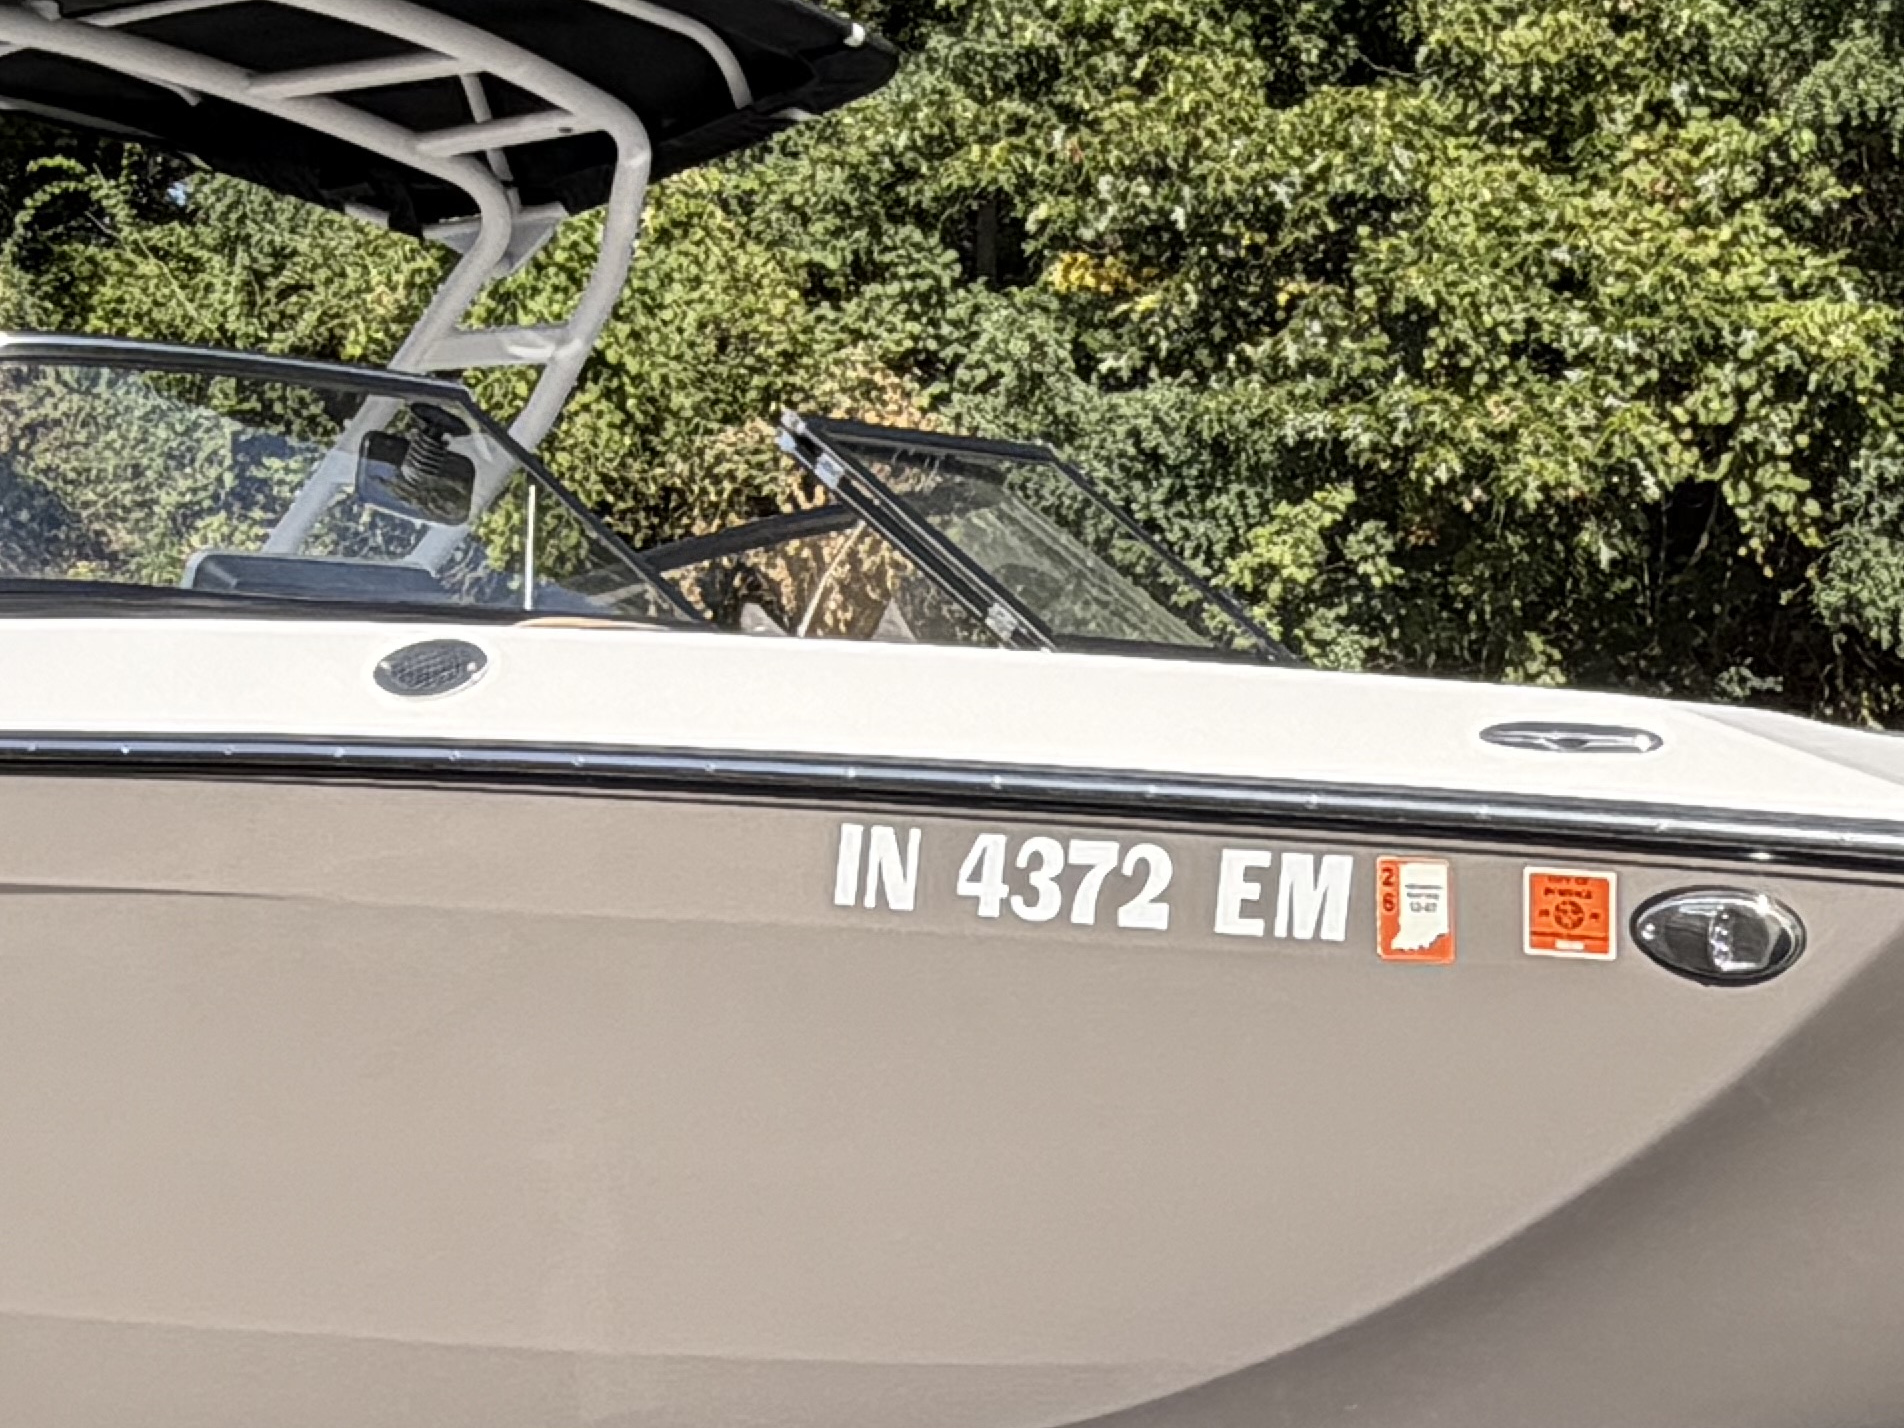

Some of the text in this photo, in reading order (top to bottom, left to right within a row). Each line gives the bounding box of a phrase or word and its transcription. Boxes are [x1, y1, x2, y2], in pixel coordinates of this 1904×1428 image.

[833, 822, 1354, 942] IN 4372 EM
